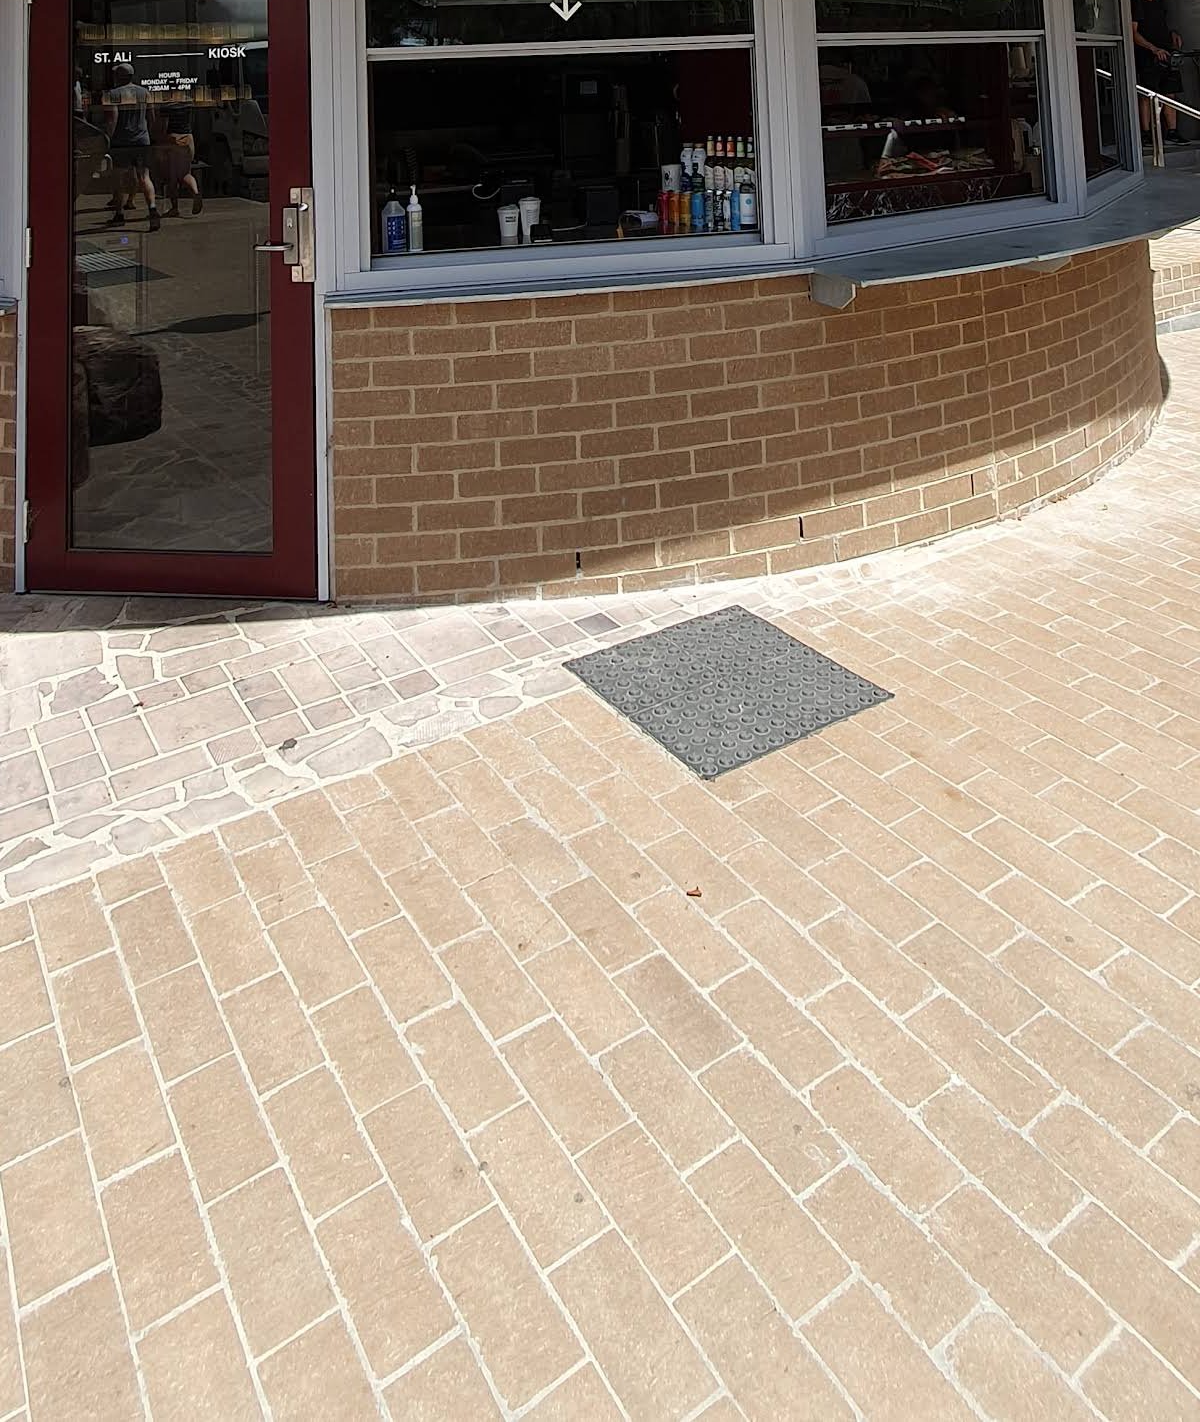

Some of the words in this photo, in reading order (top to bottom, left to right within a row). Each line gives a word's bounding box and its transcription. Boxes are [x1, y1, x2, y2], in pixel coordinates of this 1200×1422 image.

[94, 52, 111, 64] ST.
[208, 46, 247, 59] KIOSK
[158, 71, 181, 79] HOURS
[141, 78, 167, 86] MONDAY
[175, 77, 198, 85] FRIDAY
